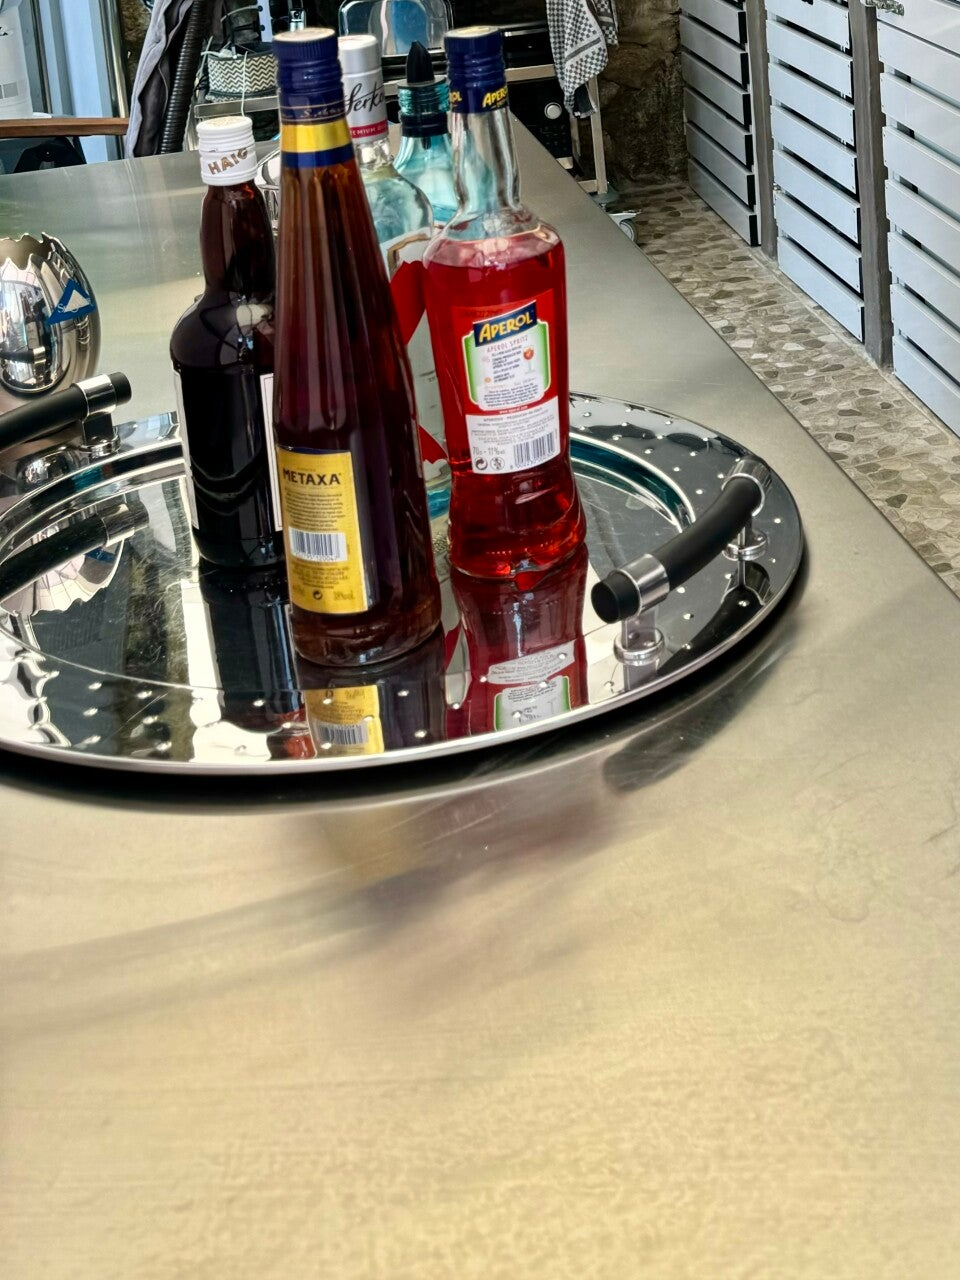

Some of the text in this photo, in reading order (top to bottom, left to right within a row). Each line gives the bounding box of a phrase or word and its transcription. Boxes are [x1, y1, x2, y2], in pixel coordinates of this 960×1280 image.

[206, 146, 250, 176] HAIG
[478, 311, 534, 343] APEROL
[283, 468, 342, 486] METAXA
